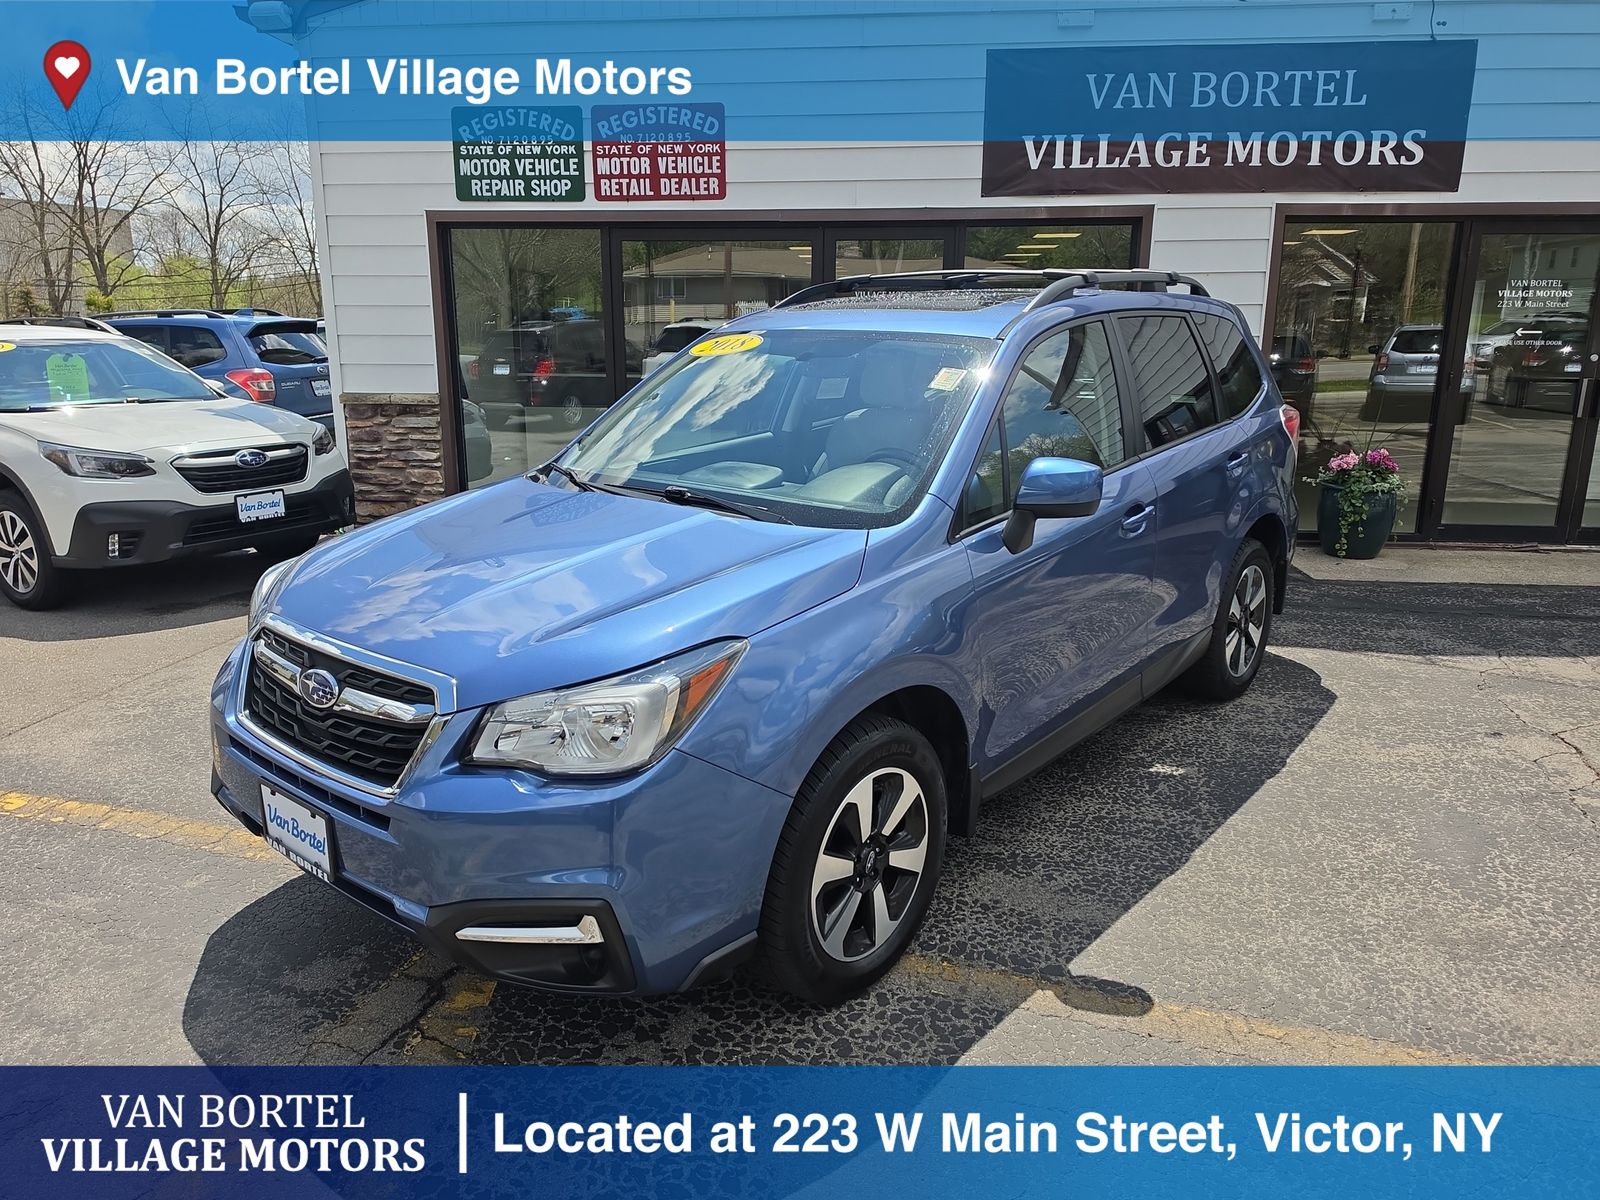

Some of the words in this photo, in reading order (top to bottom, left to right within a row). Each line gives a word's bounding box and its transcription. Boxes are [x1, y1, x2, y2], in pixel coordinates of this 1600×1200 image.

[1085, 72, 1176, 109] VAN
[1190, 69, 1368, 108] BORTEL
[458, 108, 576, 143] REGISTERED
[597, 106, 720, 139] REGISTERED
[460, 145, 494, 155] STATE
[497, 145, 513, 155] OF
[516, 145, 541, 155] NEW
[545, 145, 577, 154] YORK
[596, 145, 632, 155] STATE
[637, 145, 653, 155] OF
[657, 144, 683, 154] NEW
[688, 143, 721, 153] YORK
[1022, 131, 1213, 170] VILLAGE
[1224, 129, 1427, 168] MOTORS
[459, 158, 511, 176] MOTOR
[514, 158, 579, 176] VEHICLE
[596, 157, 651, 175] MOTOR
[657, 156, 721, 174] VEHICLE
[471, 179, 525, 197] REPAIR
[530, 179, 572, 197] SHOP
[600, 178, 654, 196] RETAIL
[660, 177, 720, 196] DEALER
[1511, 279, 1529, 287] VAN
[1530, 279, 1563, 287] BORTEL
[1497, 290, 1535, 298] VILLAGE
[1535, 290, 1574, 298] MOTORS
[1497, 300, 1513, 308] 223
[1524, 300, 1544, 308] Main
[1545, 300, 1570, 308] Street
[240, 503, 256, 513] Van
[257, 498, 281, 510] Bortel
[267, 803, 290, 834] Van
[290, 817, 326, 856] Bortel
